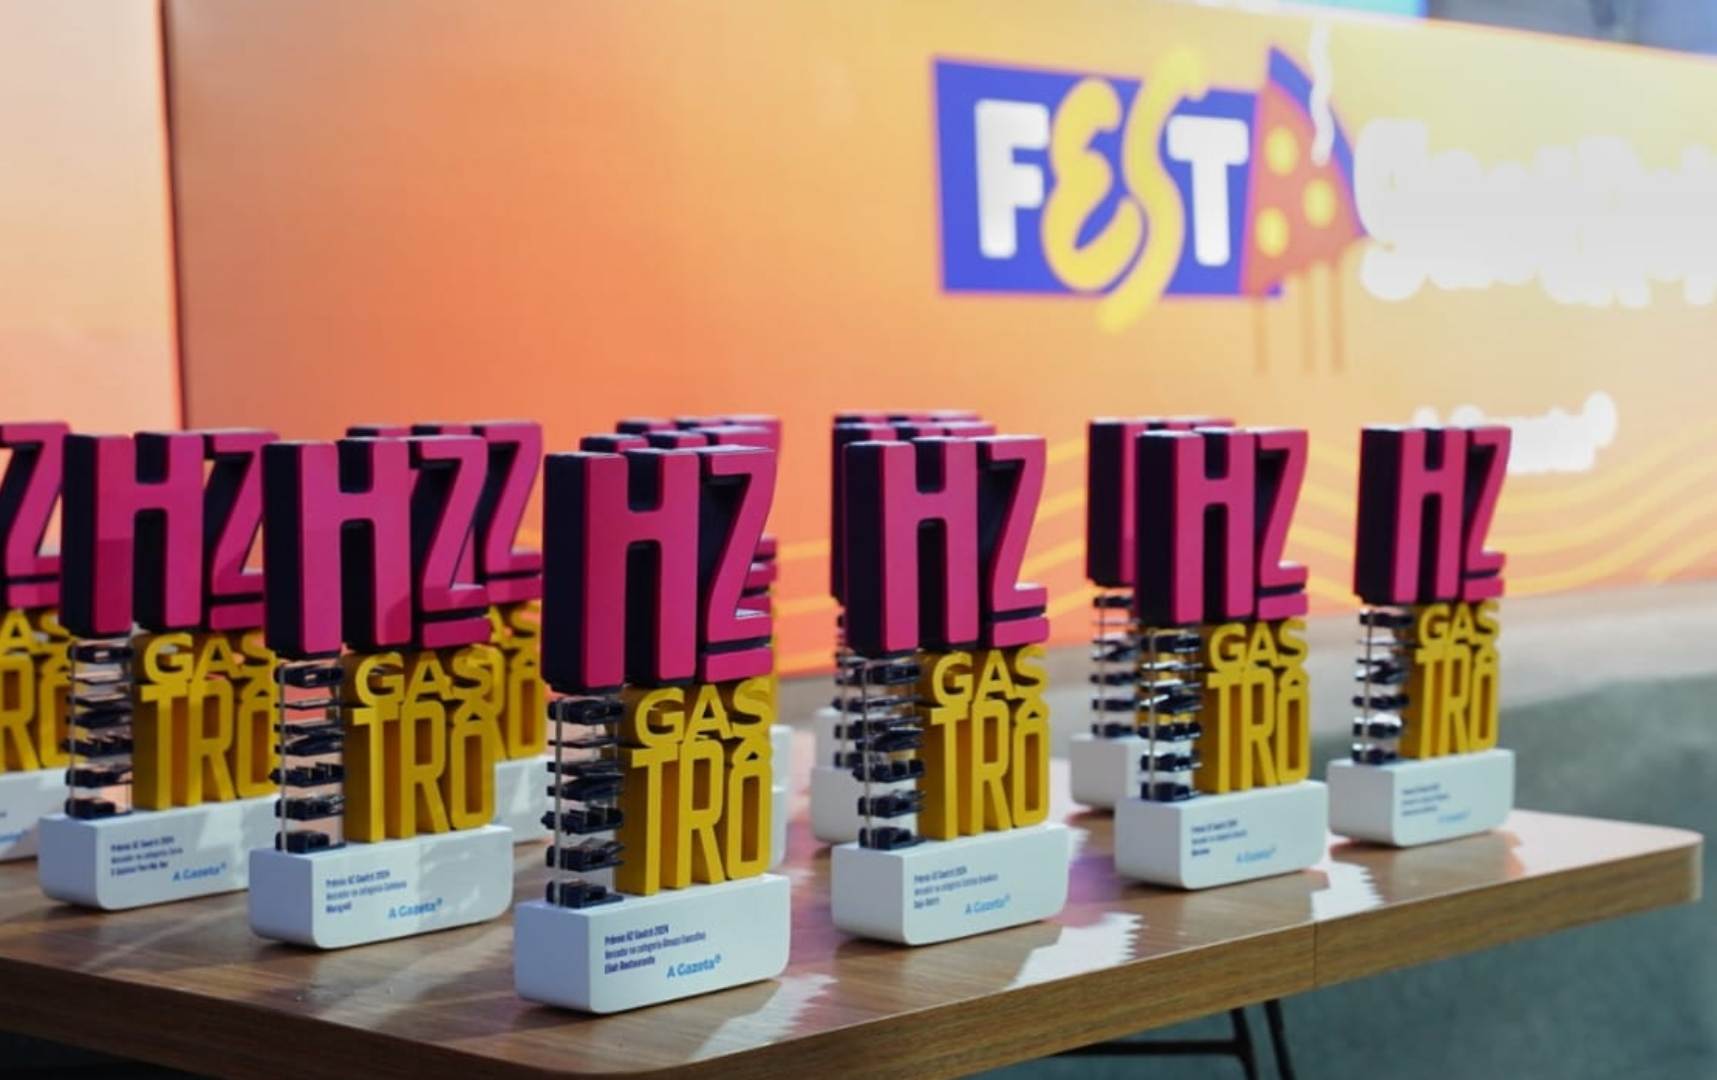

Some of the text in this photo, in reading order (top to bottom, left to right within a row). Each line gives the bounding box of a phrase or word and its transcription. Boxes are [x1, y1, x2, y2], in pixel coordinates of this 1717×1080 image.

[93, 432, 279, 635] HZ
[302, 436, 490, 654] HZ
[581, 447, 777, 688] HZ
[882, 436, 1050, 653] HZ
[1173, 428, 1309, 625] HZ
[1391, 426, 1512, 604] HZ
[143, 632, 278, 688] GAS
[354, 643, 495, 708] GAS
[931, 645, 1049, 708] GAS
[1208, 618, 1309, 673] GAS
[1418, 601, 1500, 652] GAS
[635, 677, 774, 748] GAS
[1207, 664, 1310, 794] TRÔ
[1416, 642, 1500, 760] TRÔ
[353, 697, 497, 844] TRÔ
[632, 737, 774, 896] TRÔ
[930, 699, 1050, 841] TRÔ
[666, 958, 715, 979] A Gazeta
